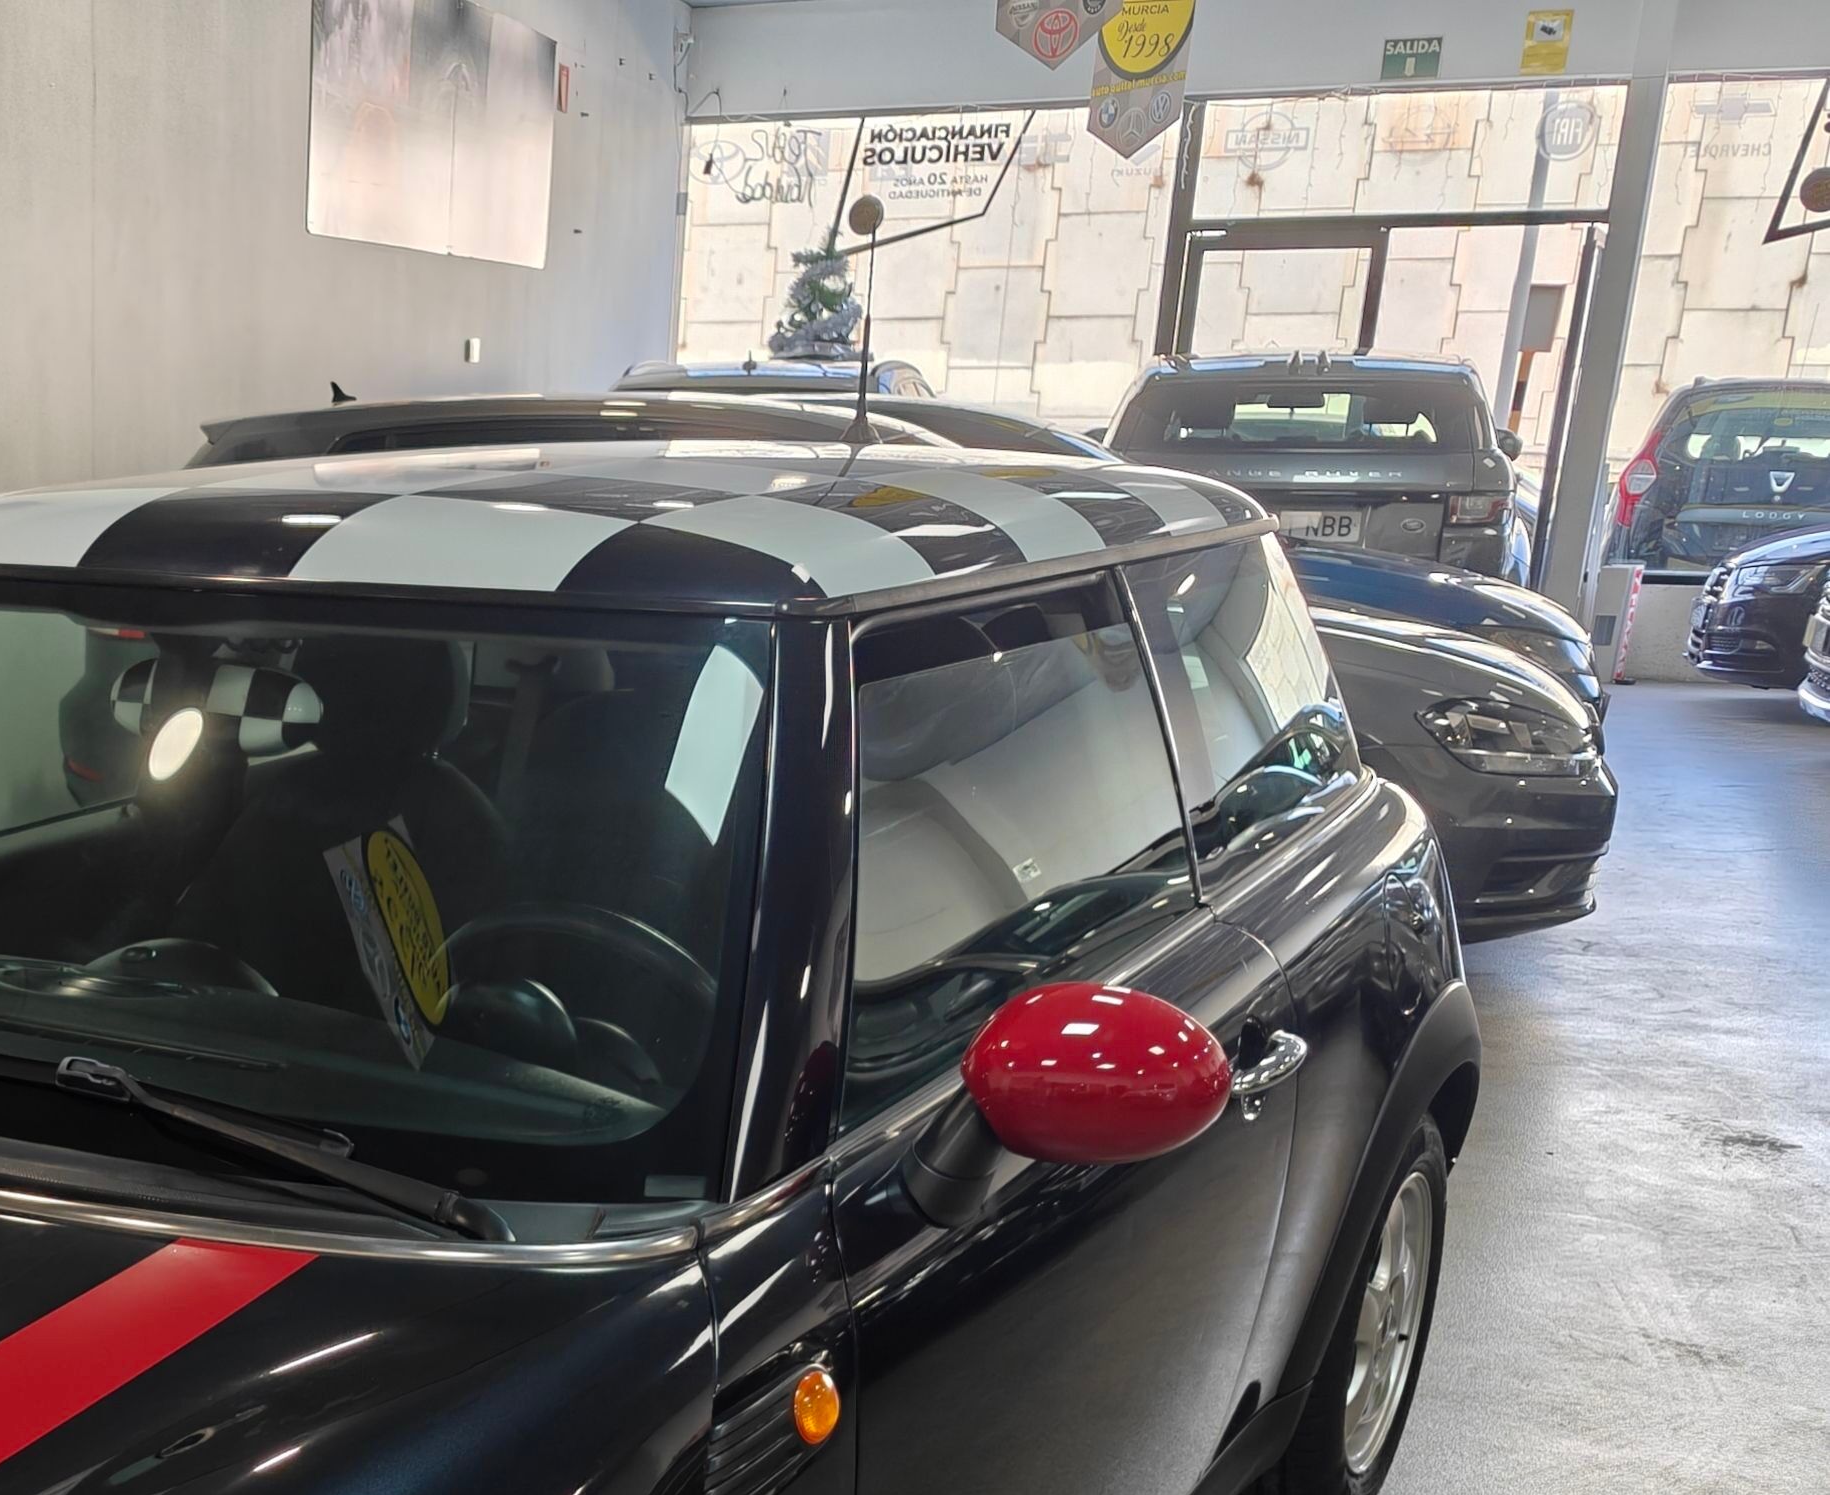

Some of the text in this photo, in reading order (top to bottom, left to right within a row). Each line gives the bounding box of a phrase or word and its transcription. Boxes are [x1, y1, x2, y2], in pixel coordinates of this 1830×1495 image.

[1122, 4, 1169, 16] MURCIA
[1123, 33, 1175, 58] 1998
[1385, 39, 1440, 55] SALIDA
[1742, 511, 1806, 520] LODGY
